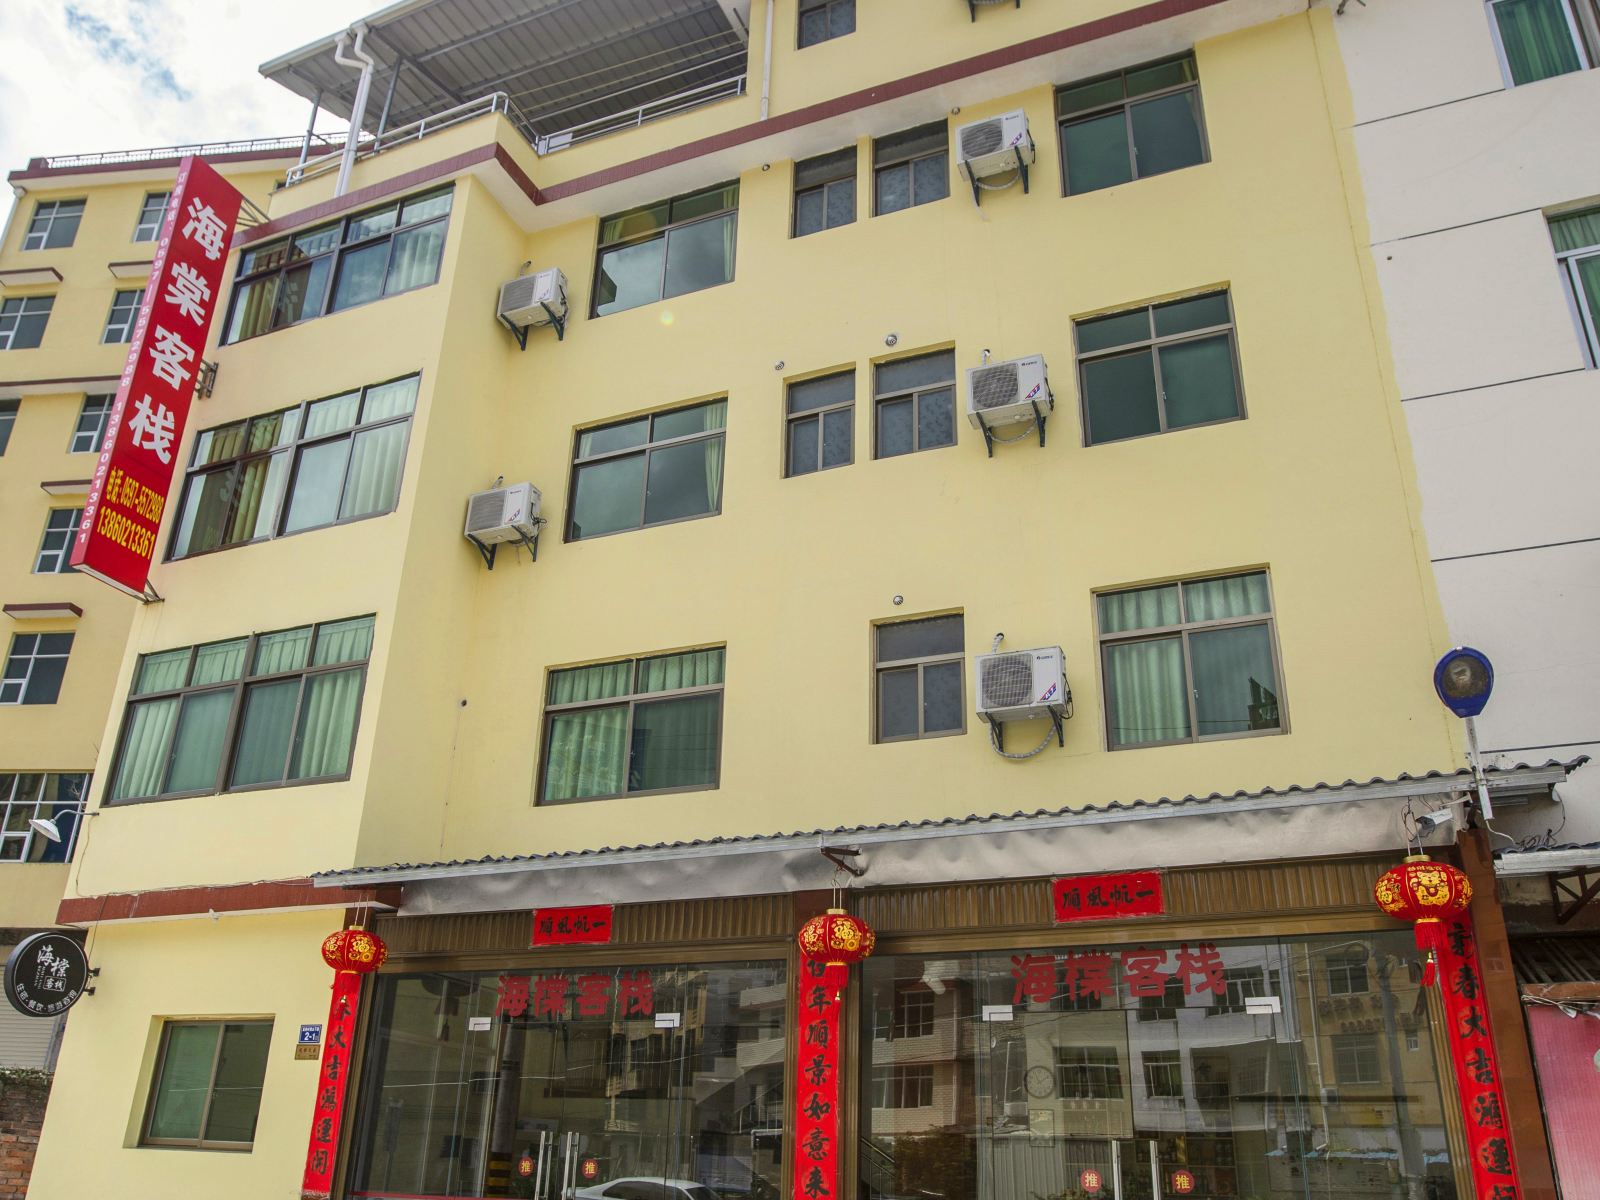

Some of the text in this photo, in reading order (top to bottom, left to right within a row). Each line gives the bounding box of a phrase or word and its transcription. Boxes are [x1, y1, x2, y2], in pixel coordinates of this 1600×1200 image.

[128, 196, 228, 465] 海棠客栈
[79, 401, 122, 544] 13860213361
[97, 505, 156, 560] 13860213361
[521, 1160, 531, 1173] 推
[585, 1161, 595, 1174] 推
[1085, 1173, 1098, 1187] 推
[1175, 1174, 1190, 1189] 推
